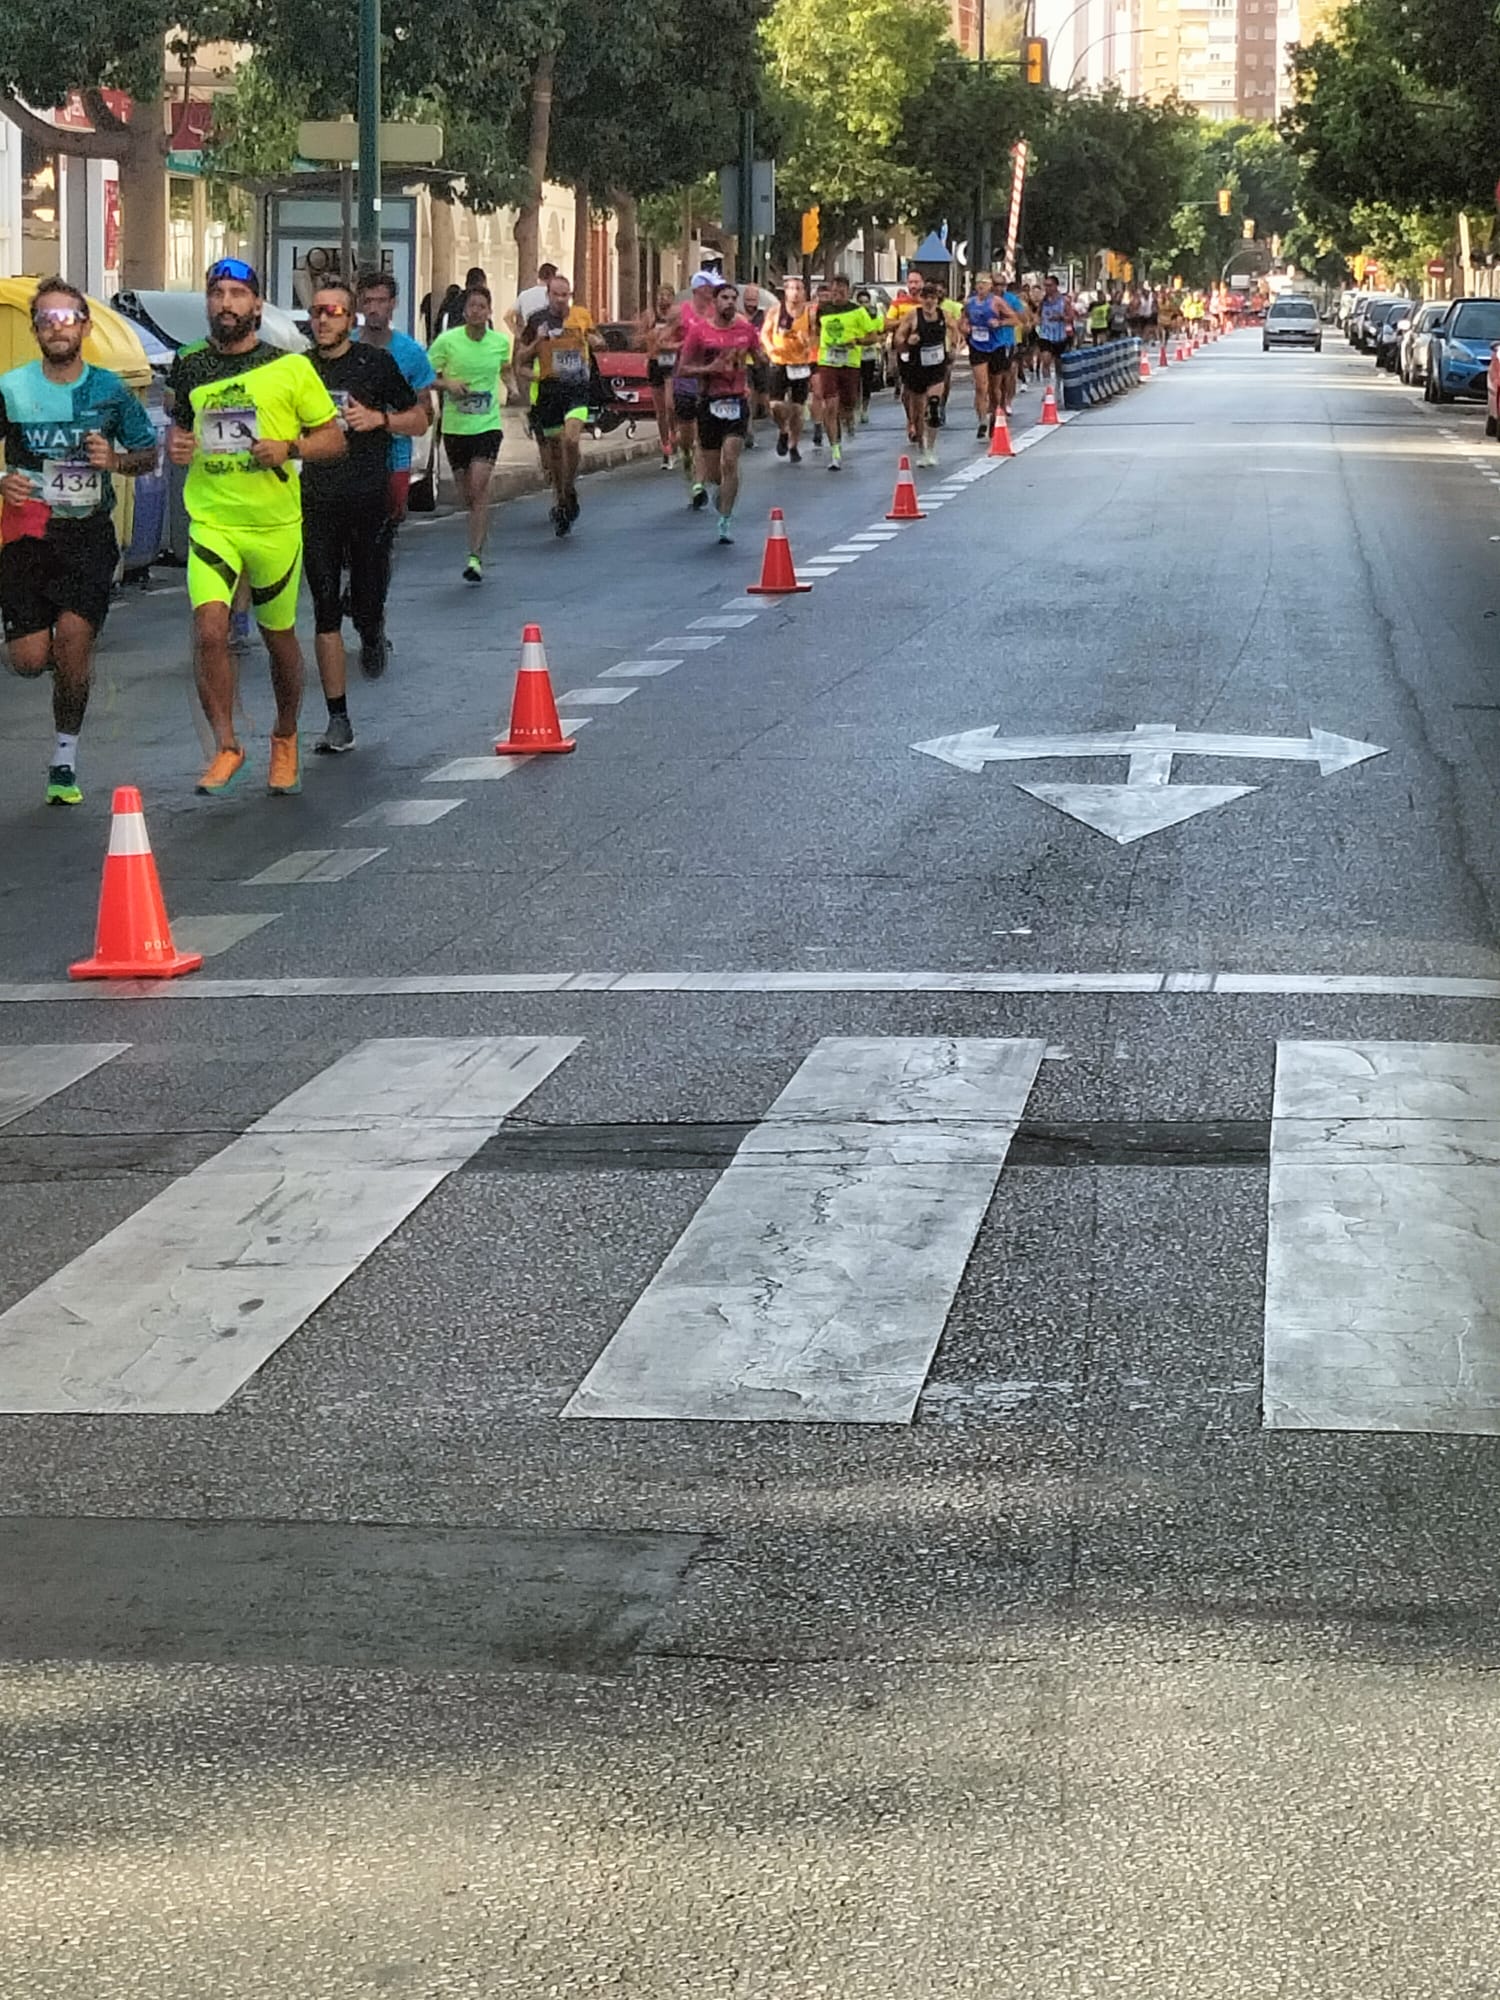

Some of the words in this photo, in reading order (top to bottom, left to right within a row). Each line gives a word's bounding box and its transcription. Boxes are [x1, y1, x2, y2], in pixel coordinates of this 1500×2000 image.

[292, 246, 394, 273] LOEE
[25, 428, 102, 447] WAT
[52, 473, 98, 492] 434
